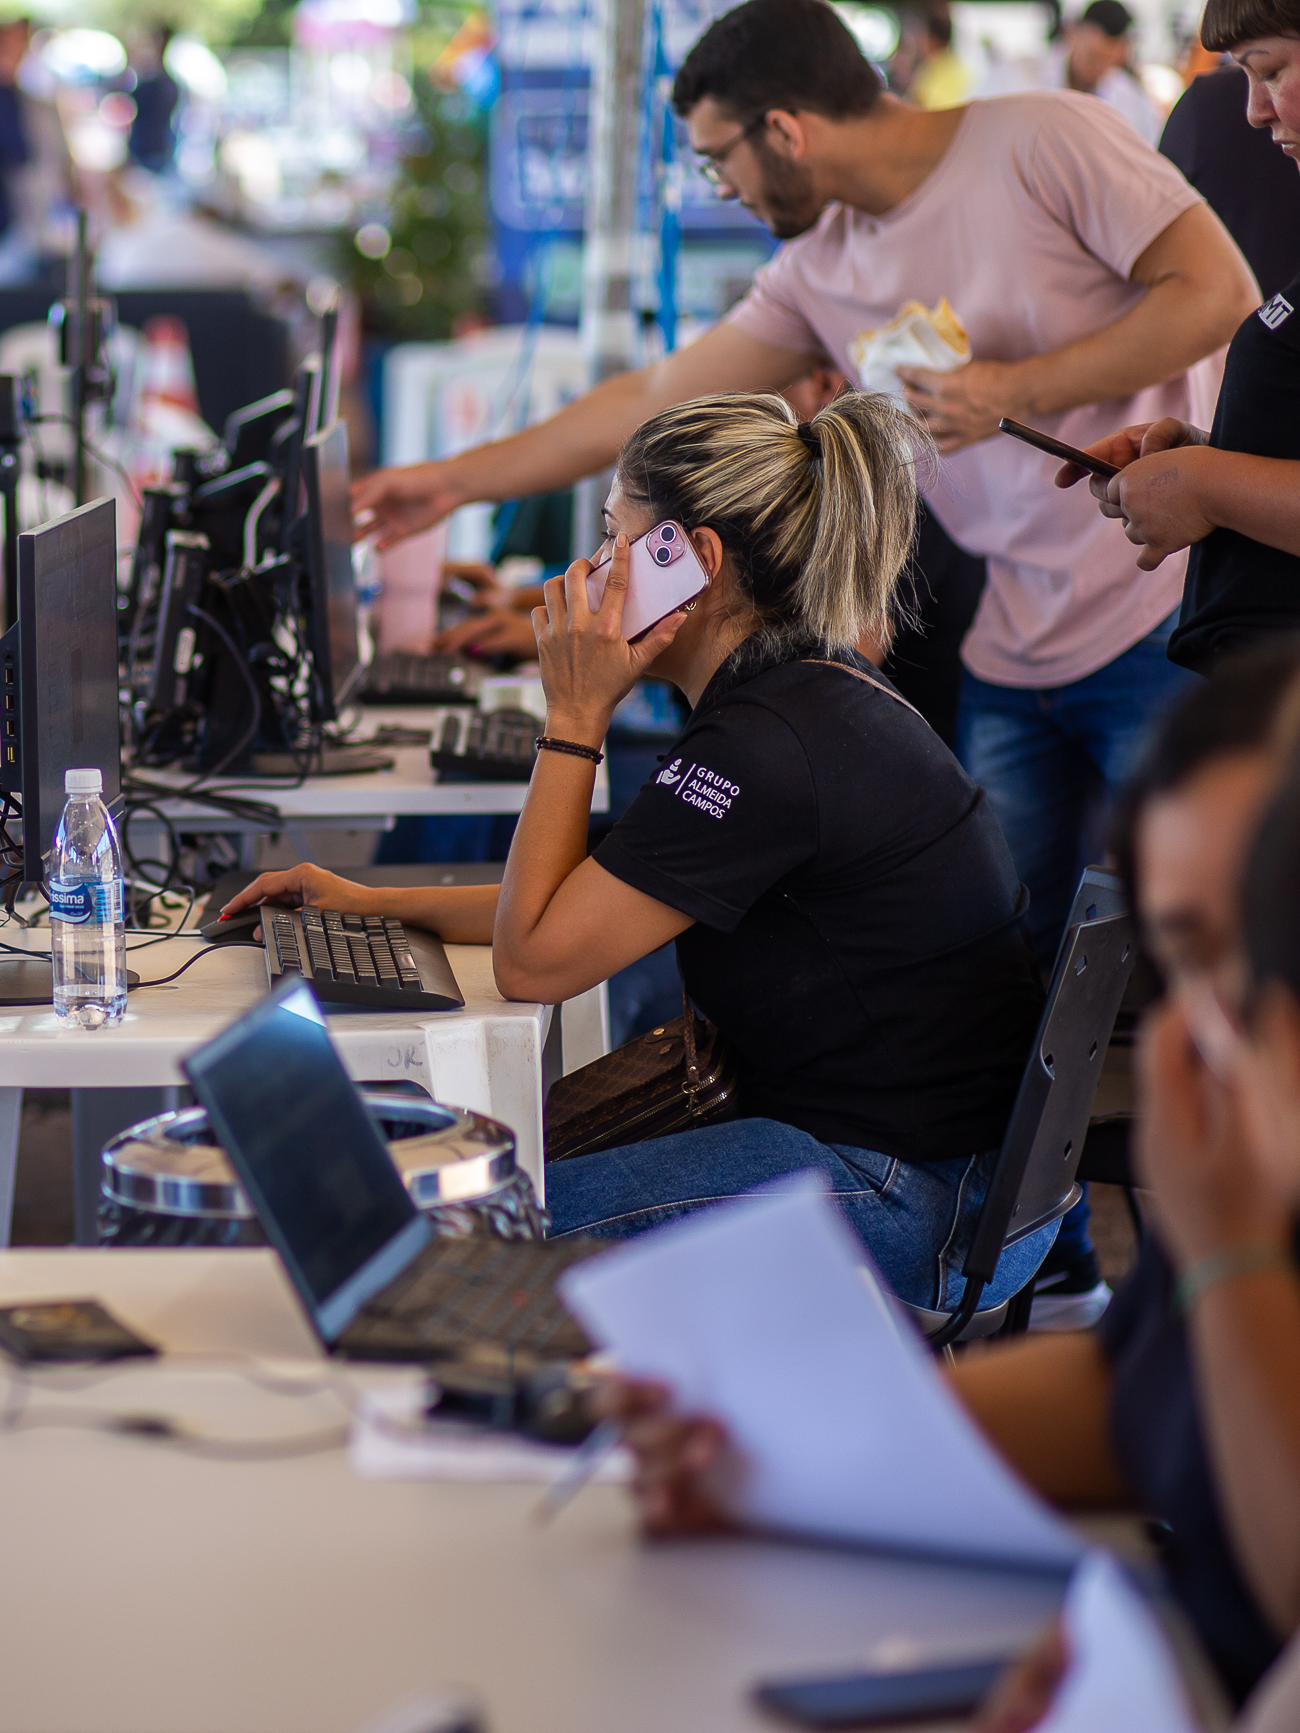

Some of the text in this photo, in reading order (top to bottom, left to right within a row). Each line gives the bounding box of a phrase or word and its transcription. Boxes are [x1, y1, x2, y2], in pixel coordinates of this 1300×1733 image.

[688, 779, 732, 809] ALMEIDA
[696, 767, 740, 796] GRUPO
[682, 790, 726, 819] CAMPOS
